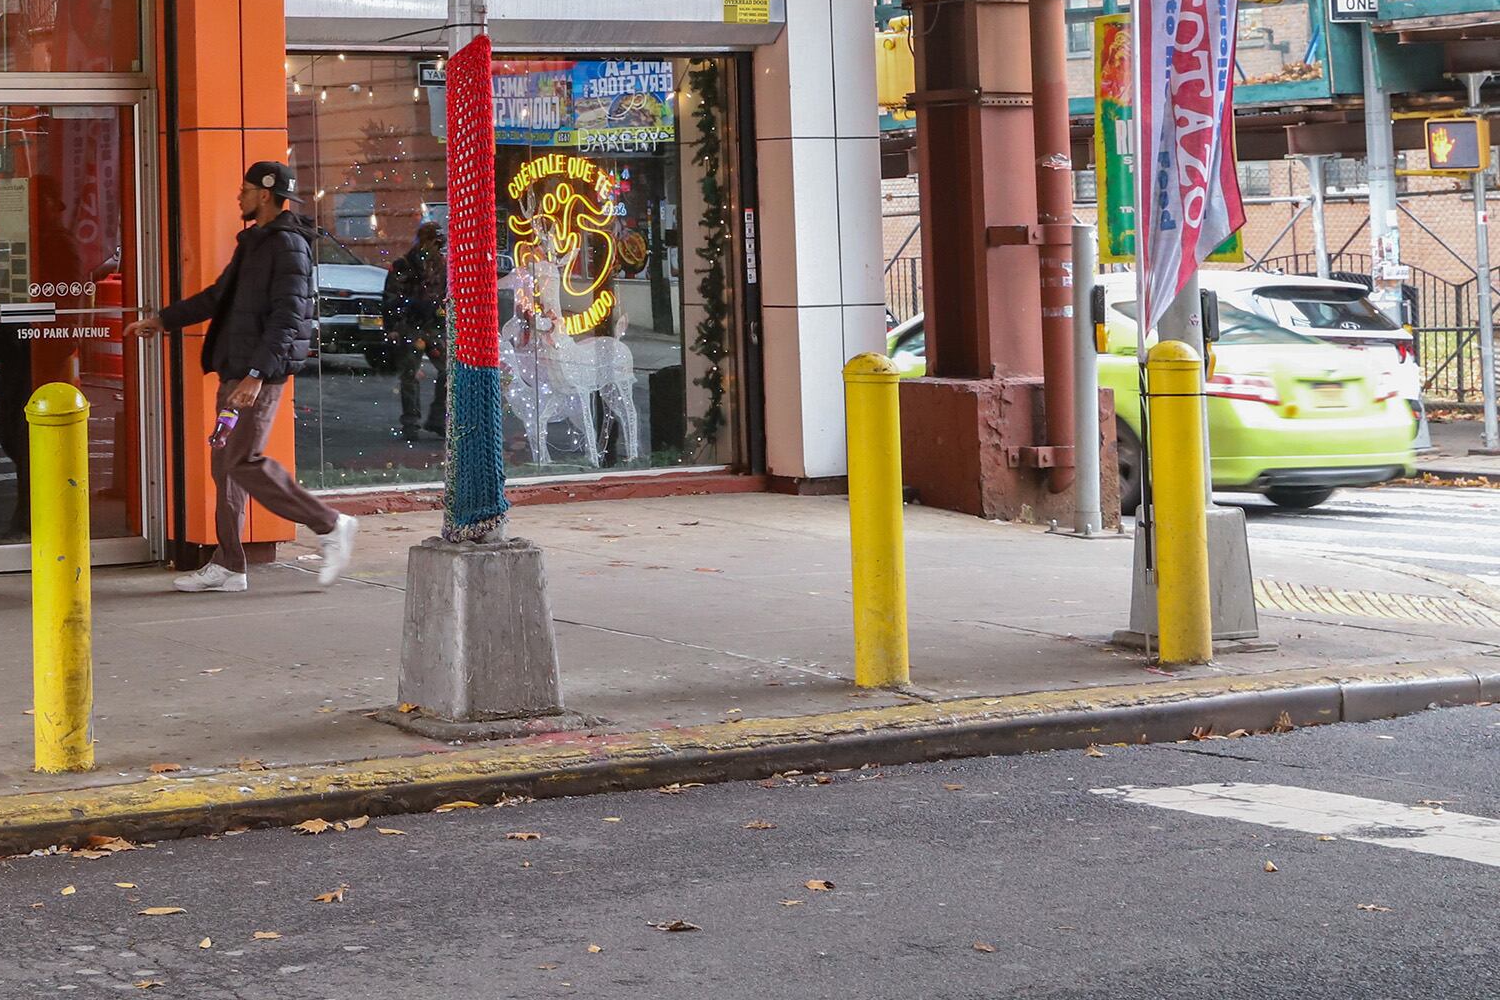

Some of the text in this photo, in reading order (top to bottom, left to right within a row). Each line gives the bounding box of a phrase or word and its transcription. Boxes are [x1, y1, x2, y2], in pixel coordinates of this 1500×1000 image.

[508, 153, 613, 200] CUÉNTALE QUE TE
[1158, 150, 1177, 232] Food
[17, 327, 111, 339] 1590 PARK AVENUE
